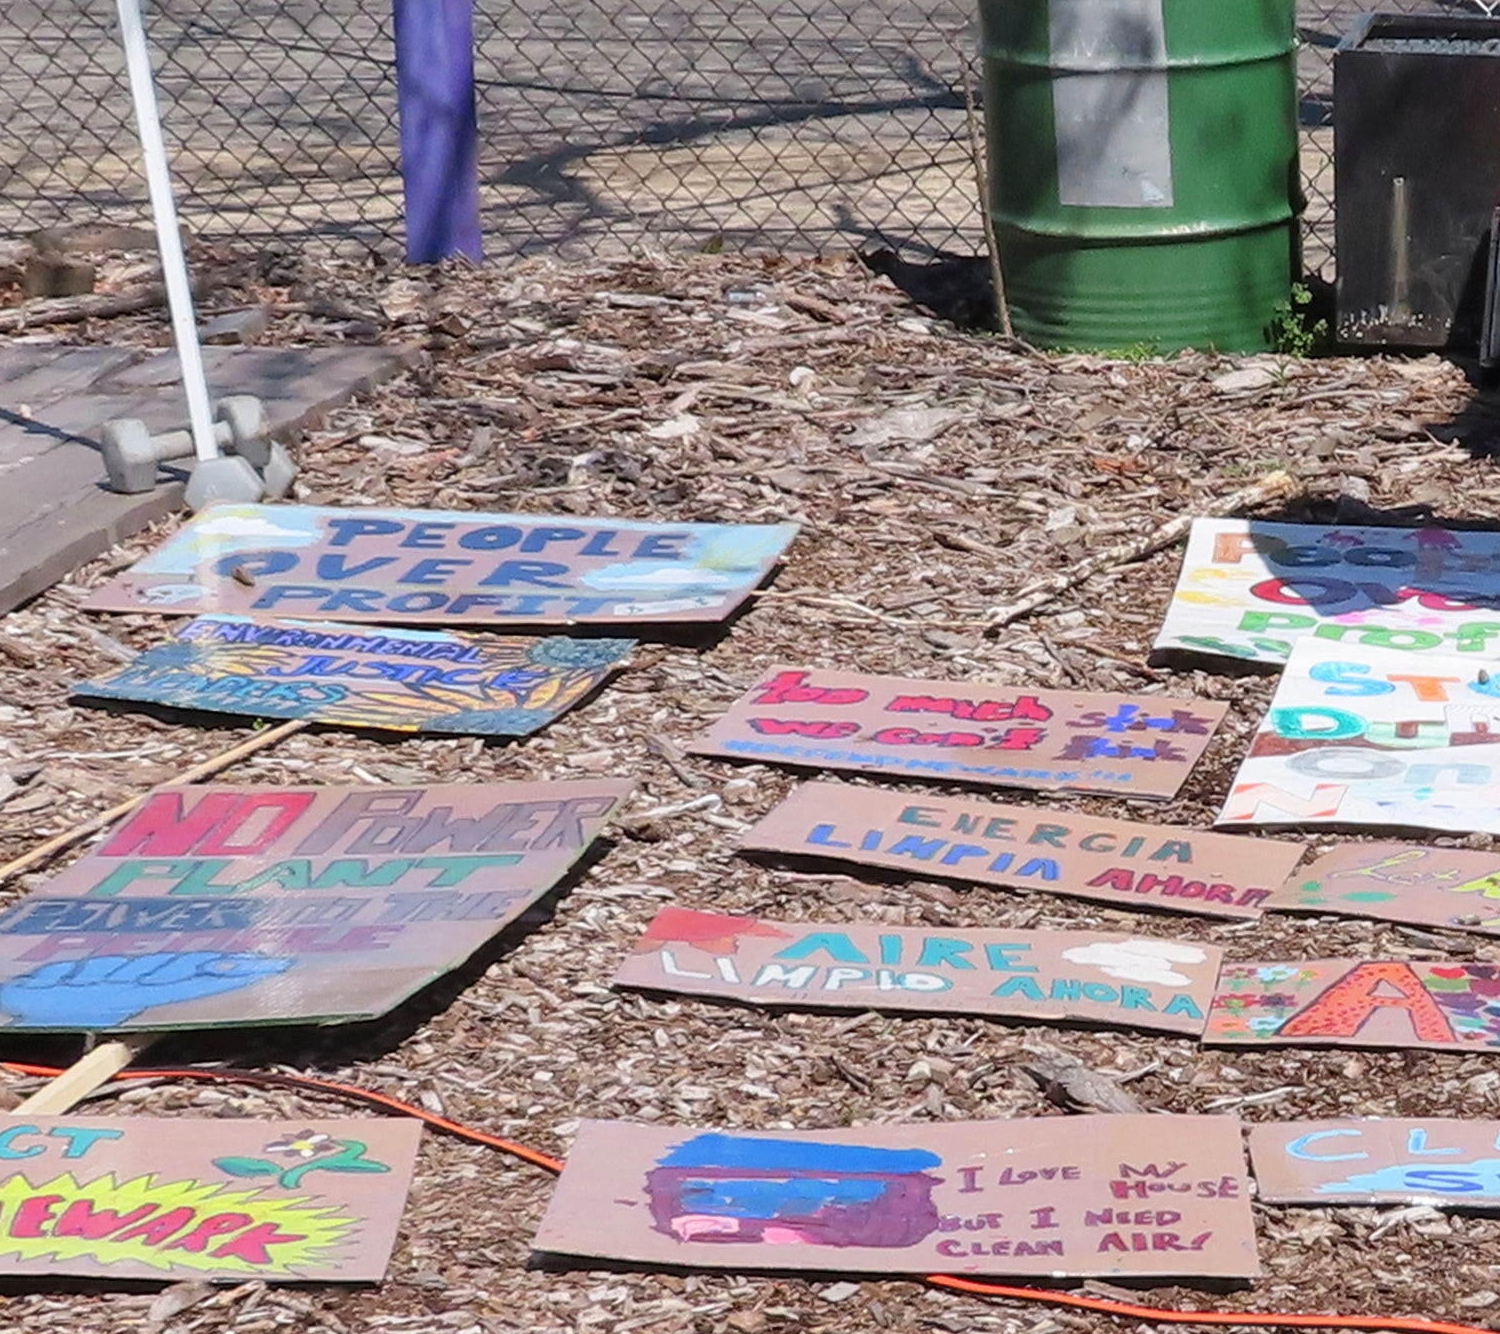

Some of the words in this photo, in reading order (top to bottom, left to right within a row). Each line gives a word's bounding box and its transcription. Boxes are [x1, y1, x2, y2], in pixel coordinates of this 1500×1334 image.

[328, 518, 696, 560] PEOPLE
[211, 549, 577, 589] OVER
[251, 584, 634, 615] PROFIT
[266, 654, 555, 691] JUSTICE
[101, 791, 316, 857] NO
[305, 788, 622, 857] POWER
[896, 805, 1194, 864] ENERGIA
[804, 823, 1062, 882] LIMPIA
[88, 854, 522, 898] PLANT
[773, 931, 1040, 973] AIRE
[660, 950, 954, 994] LIMPIO
[993, 977, 1206, 1021] AHORA
[957, 1166, 985, 1193] I
[1118, 1160, 1190, 1180] MY
[1029, 1206, 1060, 1230] I
[1083, 1207, 1183, 1229] NEED
[935, 1238, 1066, 1258] CLEAN
